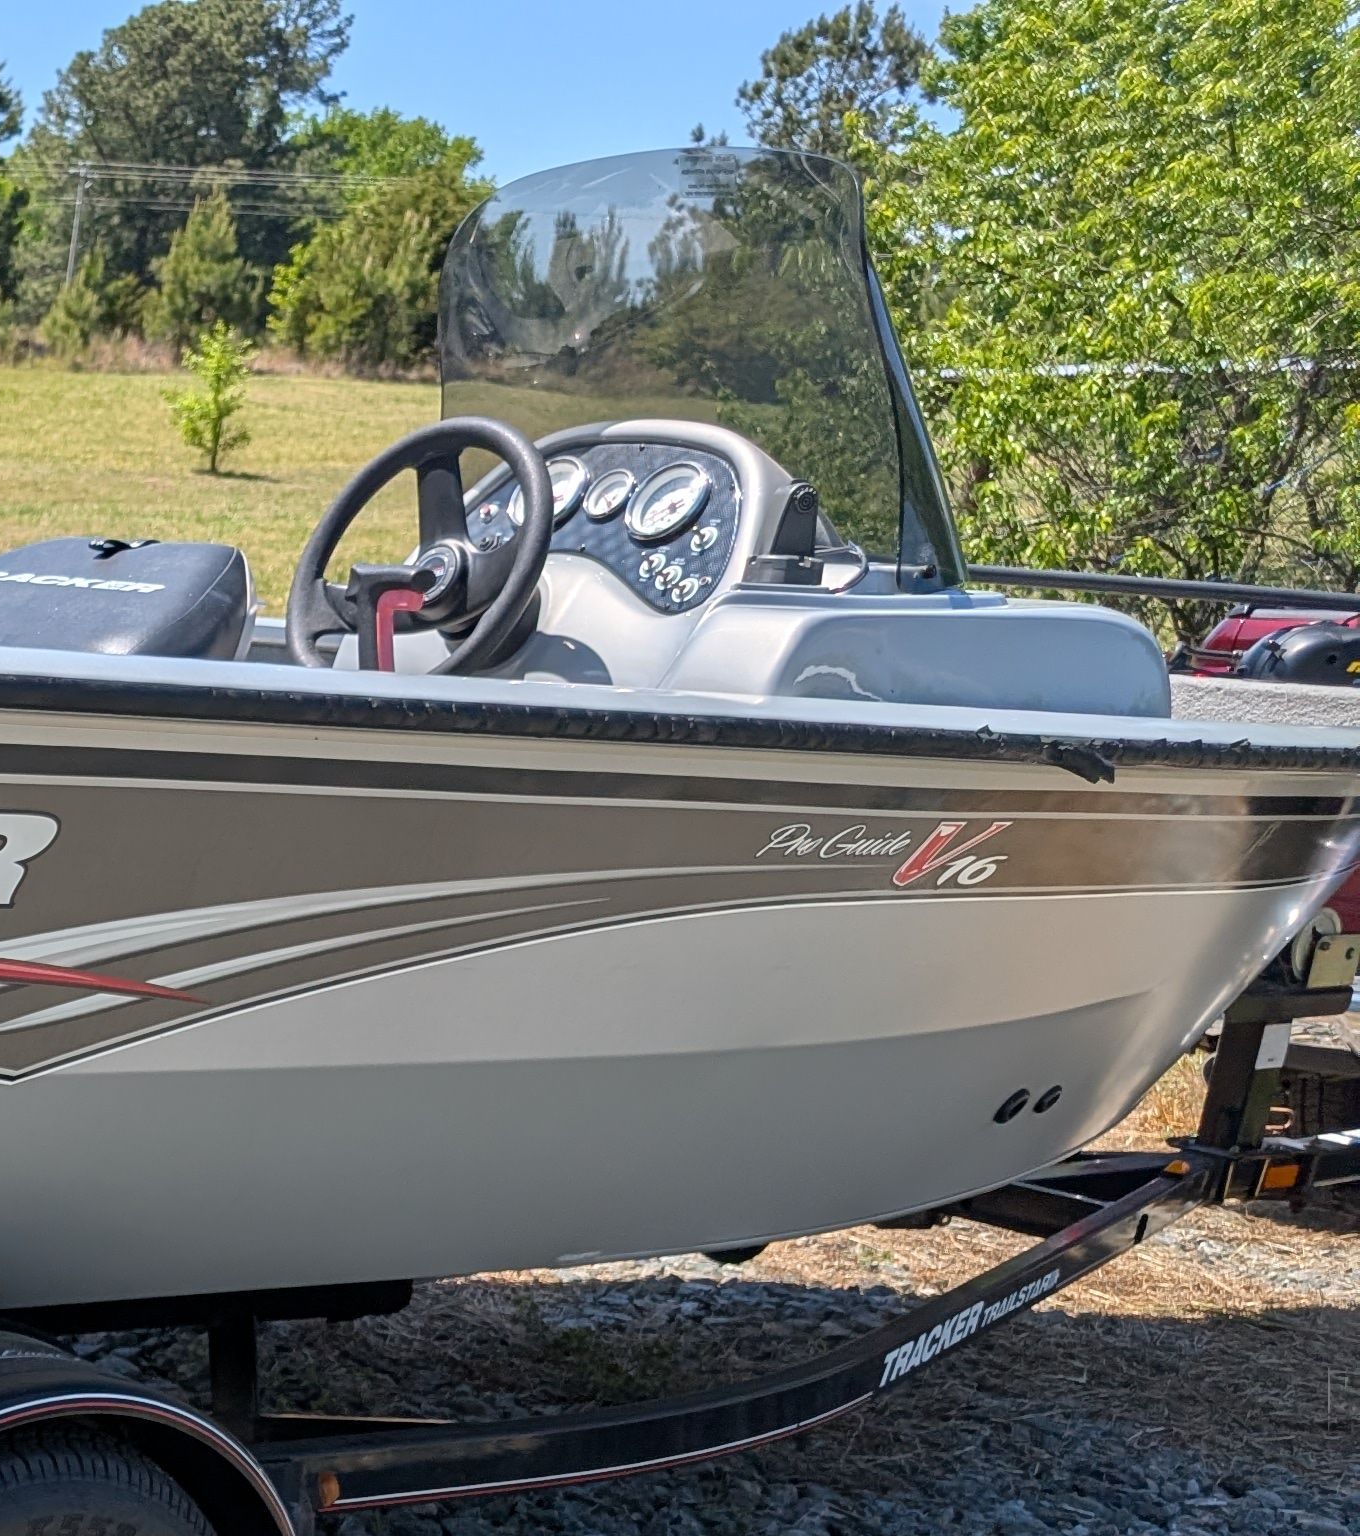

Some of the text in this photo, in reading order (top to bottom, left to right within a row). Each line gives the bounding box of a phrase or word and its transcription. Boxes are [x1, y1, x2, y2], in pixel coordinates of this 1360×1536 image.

[755, 822, 823, 858] Pro
[819, 824, 911, 859] Guide
[879, 1300, 984, 1388] TRACKER
